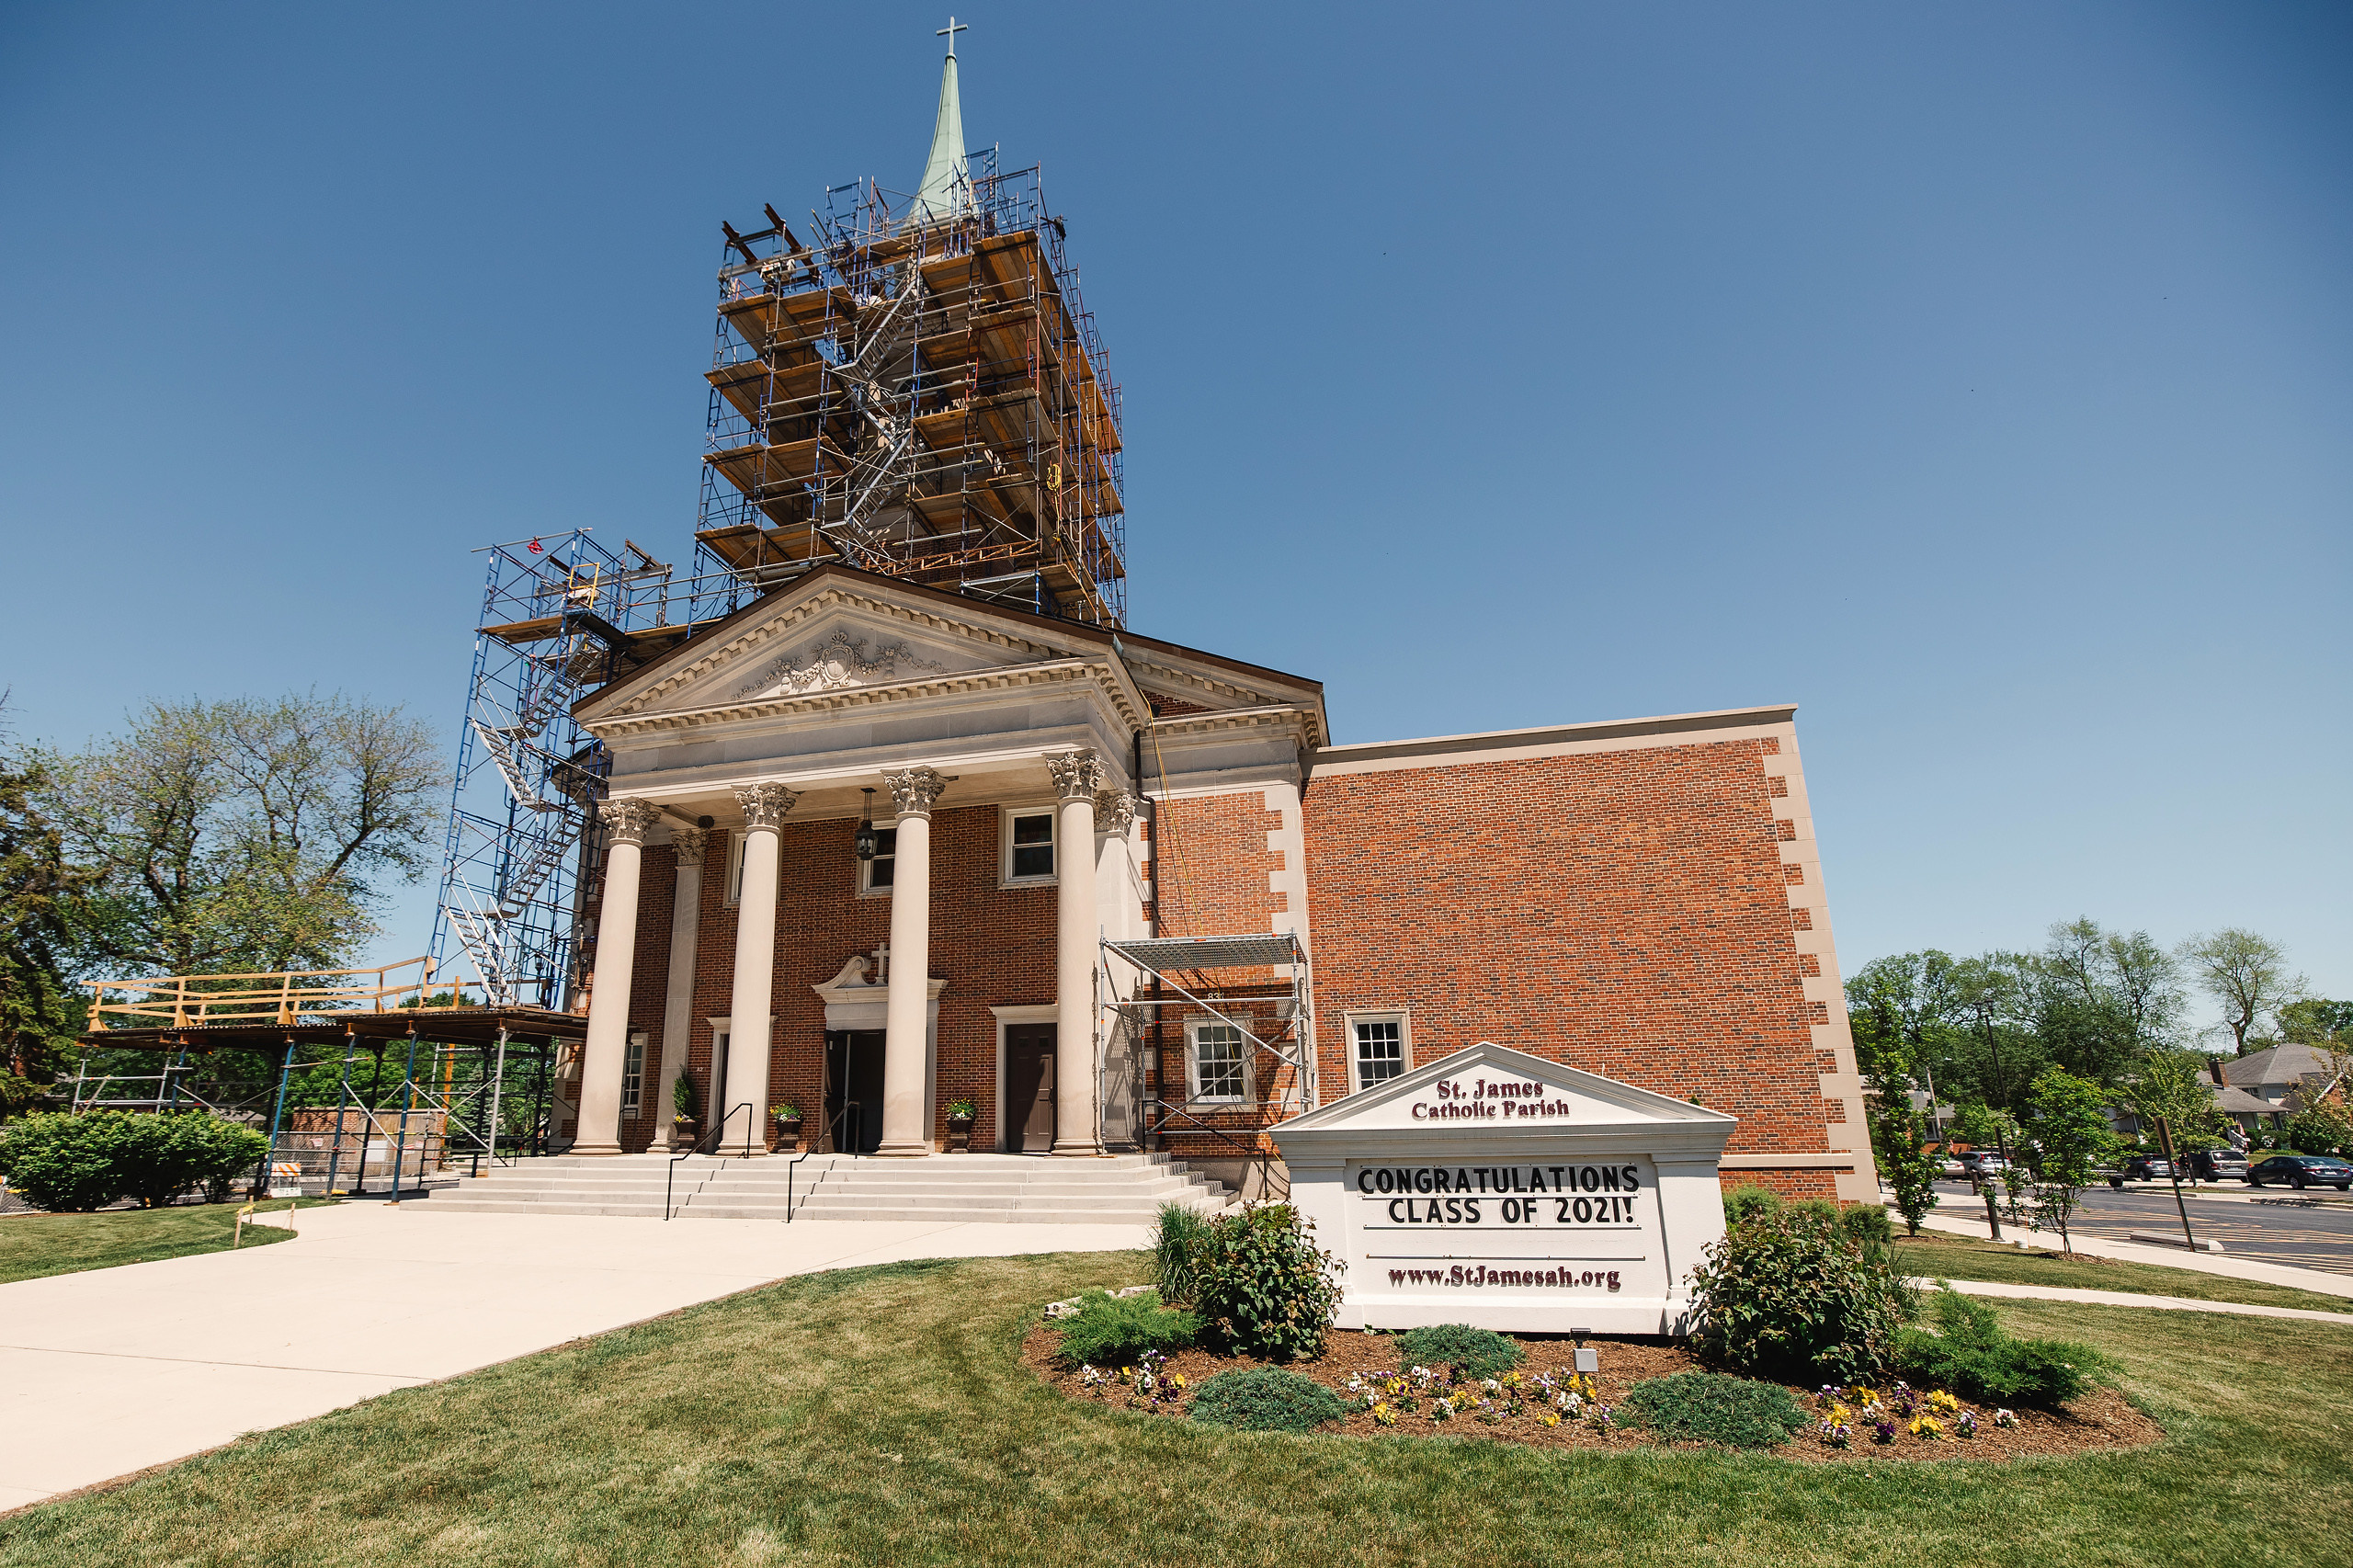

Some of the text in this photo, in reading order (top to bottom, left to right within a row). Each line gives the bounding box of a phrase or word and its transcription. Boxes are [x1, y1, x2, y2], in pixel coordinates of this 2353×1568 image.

[1437, 1079, 1544, 1098] St. James
[1412, 1099, 1570, 1119] Catholic Parish
[1358, 1166, 1641, 1194] CONGRATULATIONS
[1388, 1197, 1634, 1223] CLASS OF 2021!
[1388, 1265, 1621, 1292] www.StJamesah.org
